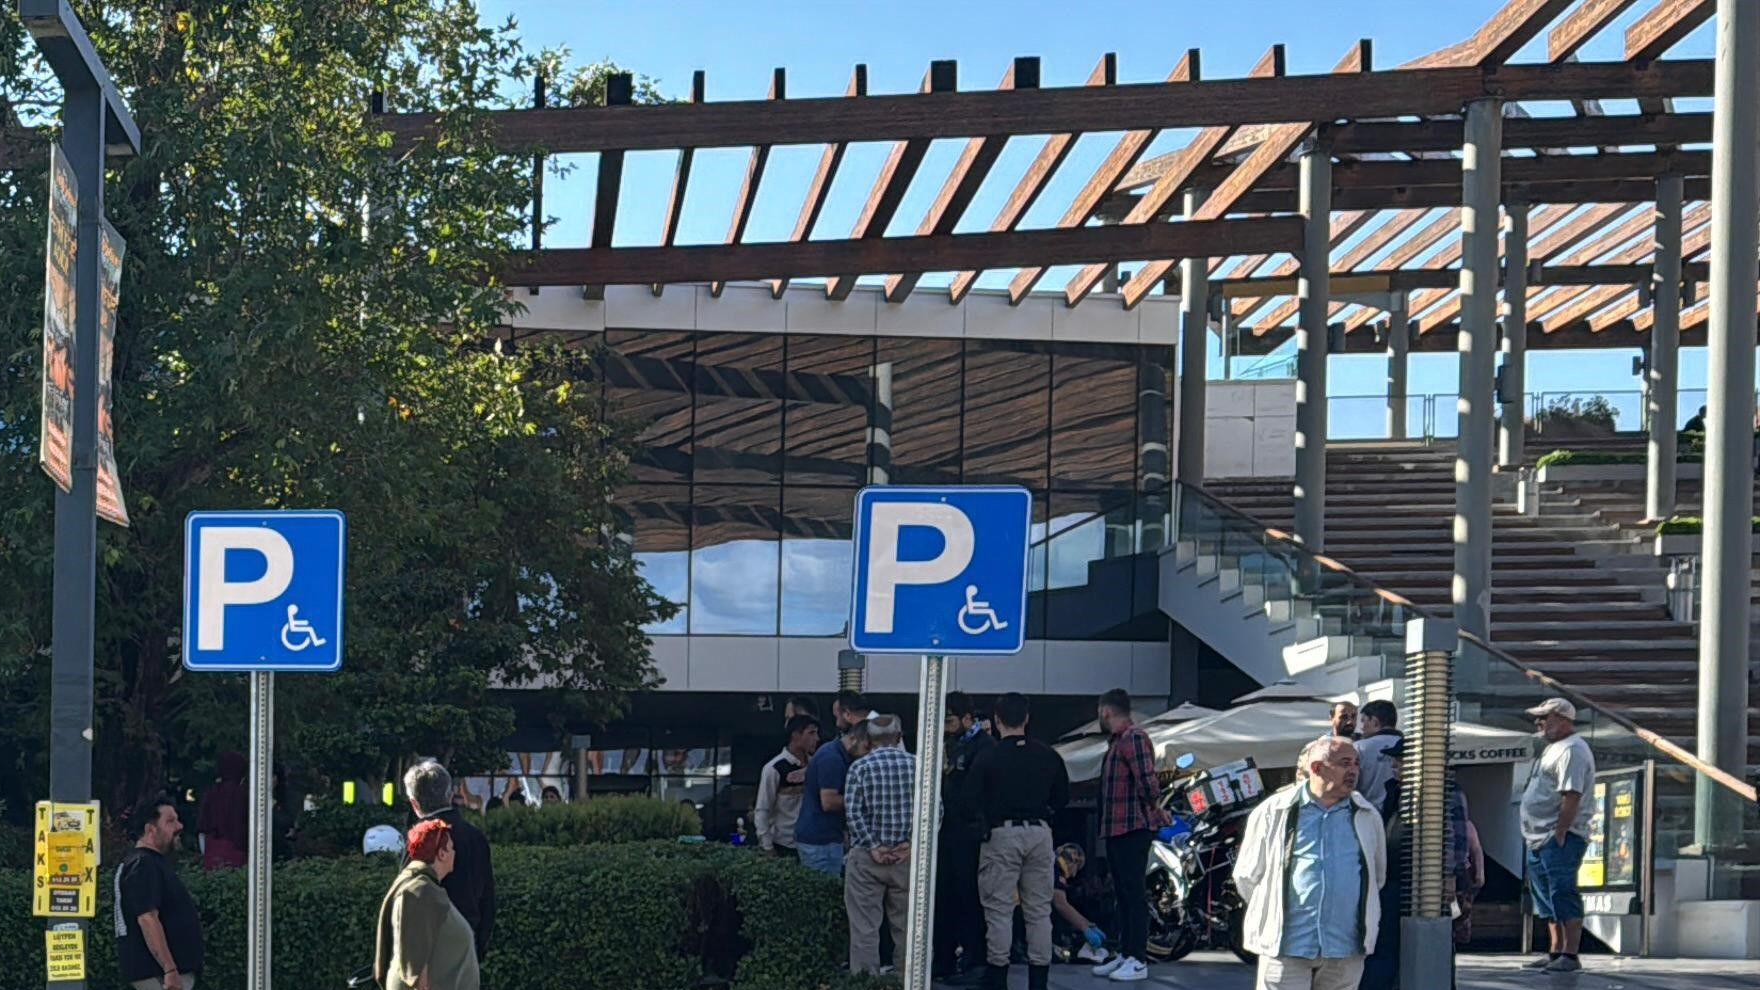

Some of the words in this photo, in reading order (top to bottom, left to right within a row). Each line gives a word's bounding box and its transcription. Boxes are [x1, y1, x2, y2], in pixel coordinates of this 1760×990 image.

[198, 526, 294, 650] P
[865, 502, 974, 633] P
[1479, 747, 1527, 759] COFFEE
